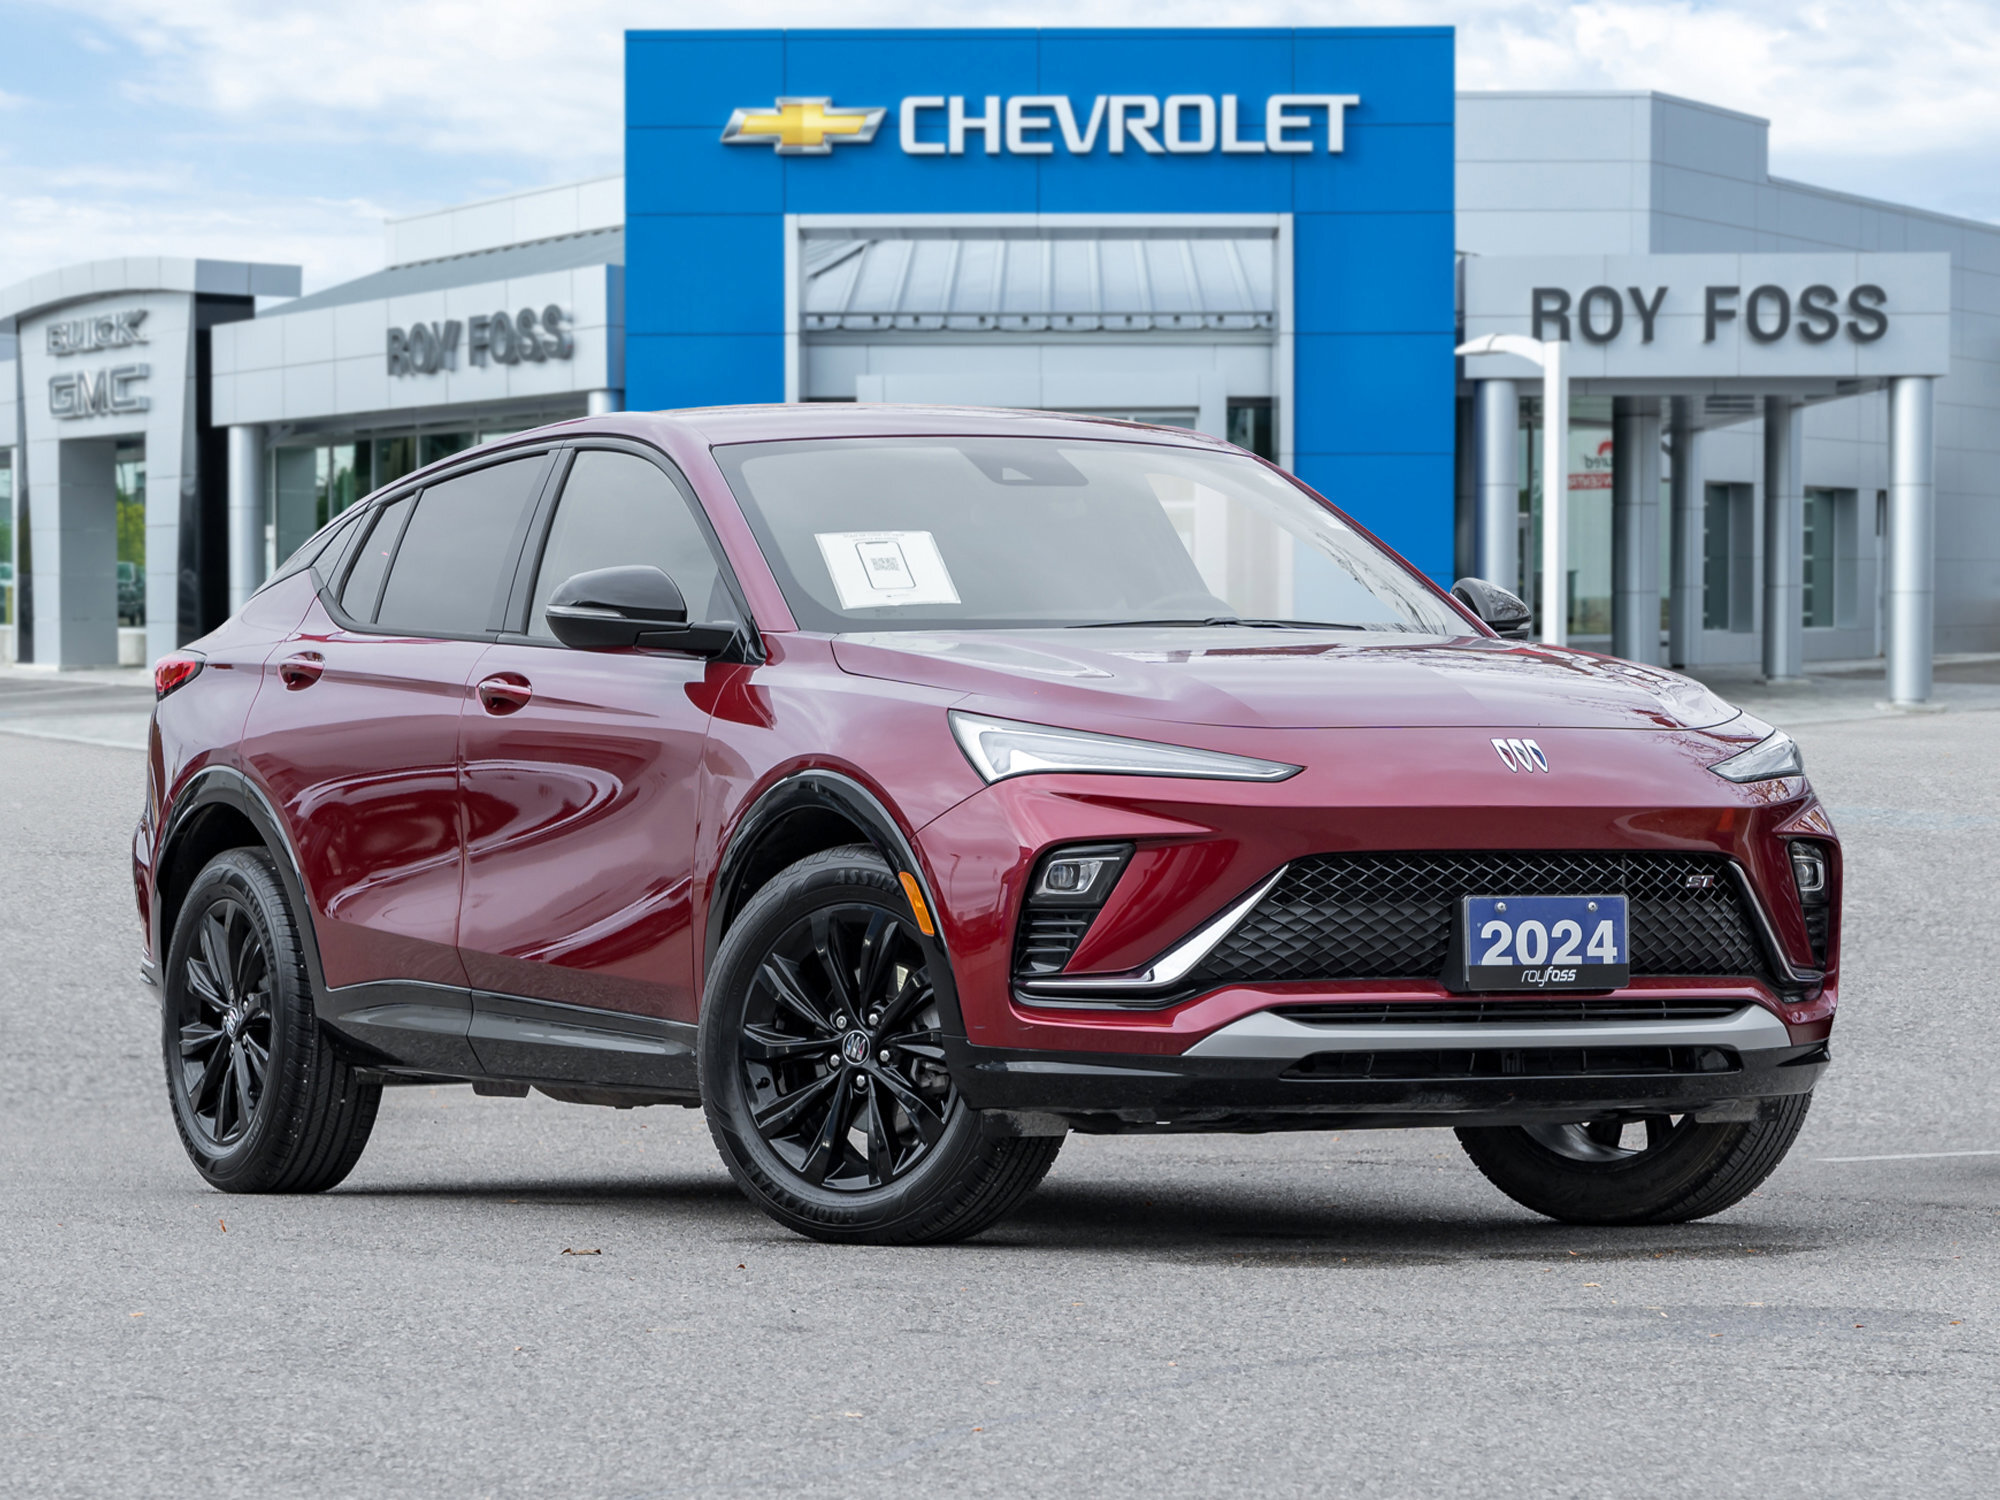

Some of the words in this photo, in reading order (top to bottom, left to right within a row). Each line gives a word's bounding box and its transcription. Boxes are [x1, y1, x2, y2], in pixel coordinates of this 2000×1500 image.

[900, 94, 1360, 155] CHEVROLET
[46, 309, 149, 356] BUICK
[386, 318, 463, 376] ROY
[468, 303, 575, 366] FOSS
[1532, 285, 1669, 344] ROY
[1703, 283, 1889, 345] FOSS
[48, 363, 151, 420] GMC
[832, 868, 902, 897] ASSUR
[1480, 919, 1618, 966] 2024
